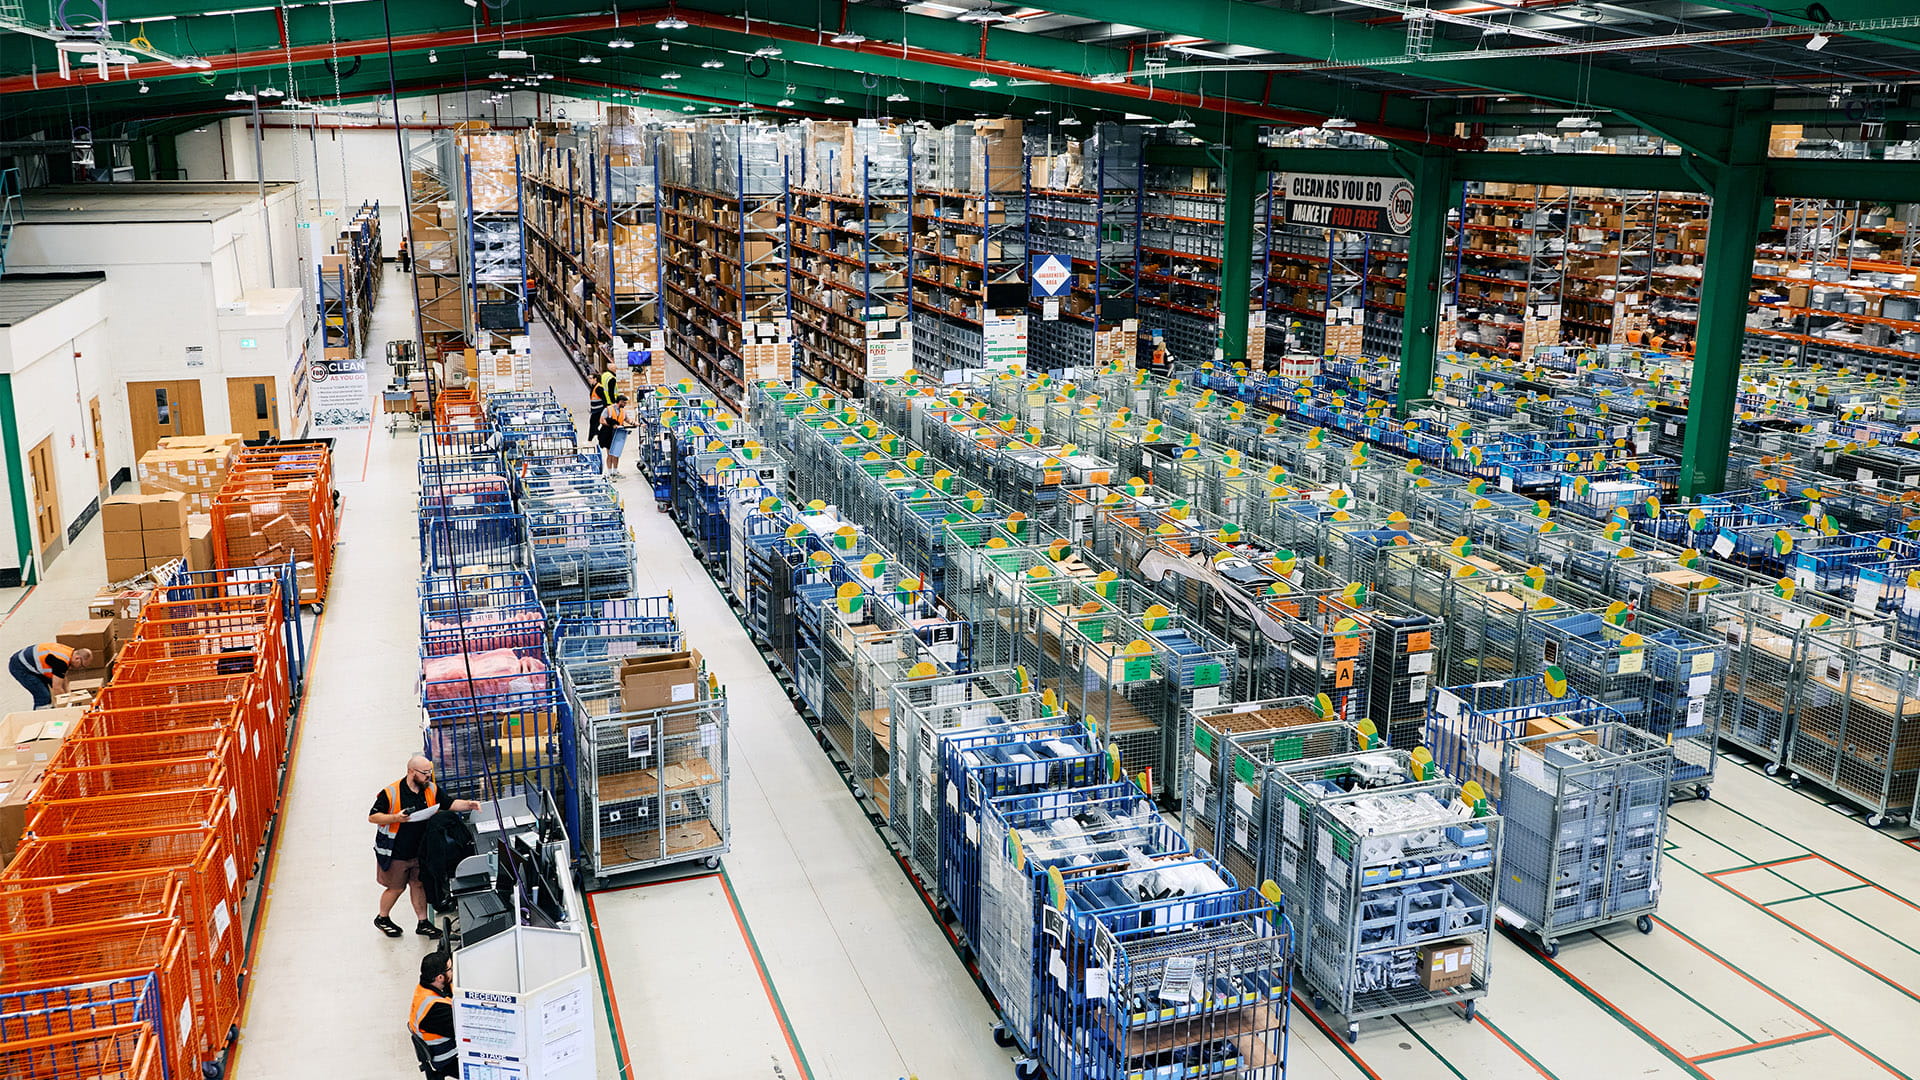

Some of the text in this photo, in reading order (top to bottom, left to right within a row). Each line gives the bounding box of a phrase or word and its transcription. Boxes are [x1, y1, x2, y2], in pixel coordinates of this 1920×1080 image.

[1293, 178, 1382, 202] CLEAN AS YOU GO
[1395, 199, 1411, 214] FOD
[1292, 204, 1380, 229] MAKE IT FOD FREE
[329, 362, 365, 372] CLEAN
[1340, 668, 1350, 680] A
[469, 991, 512, 1003] RECEIVING
